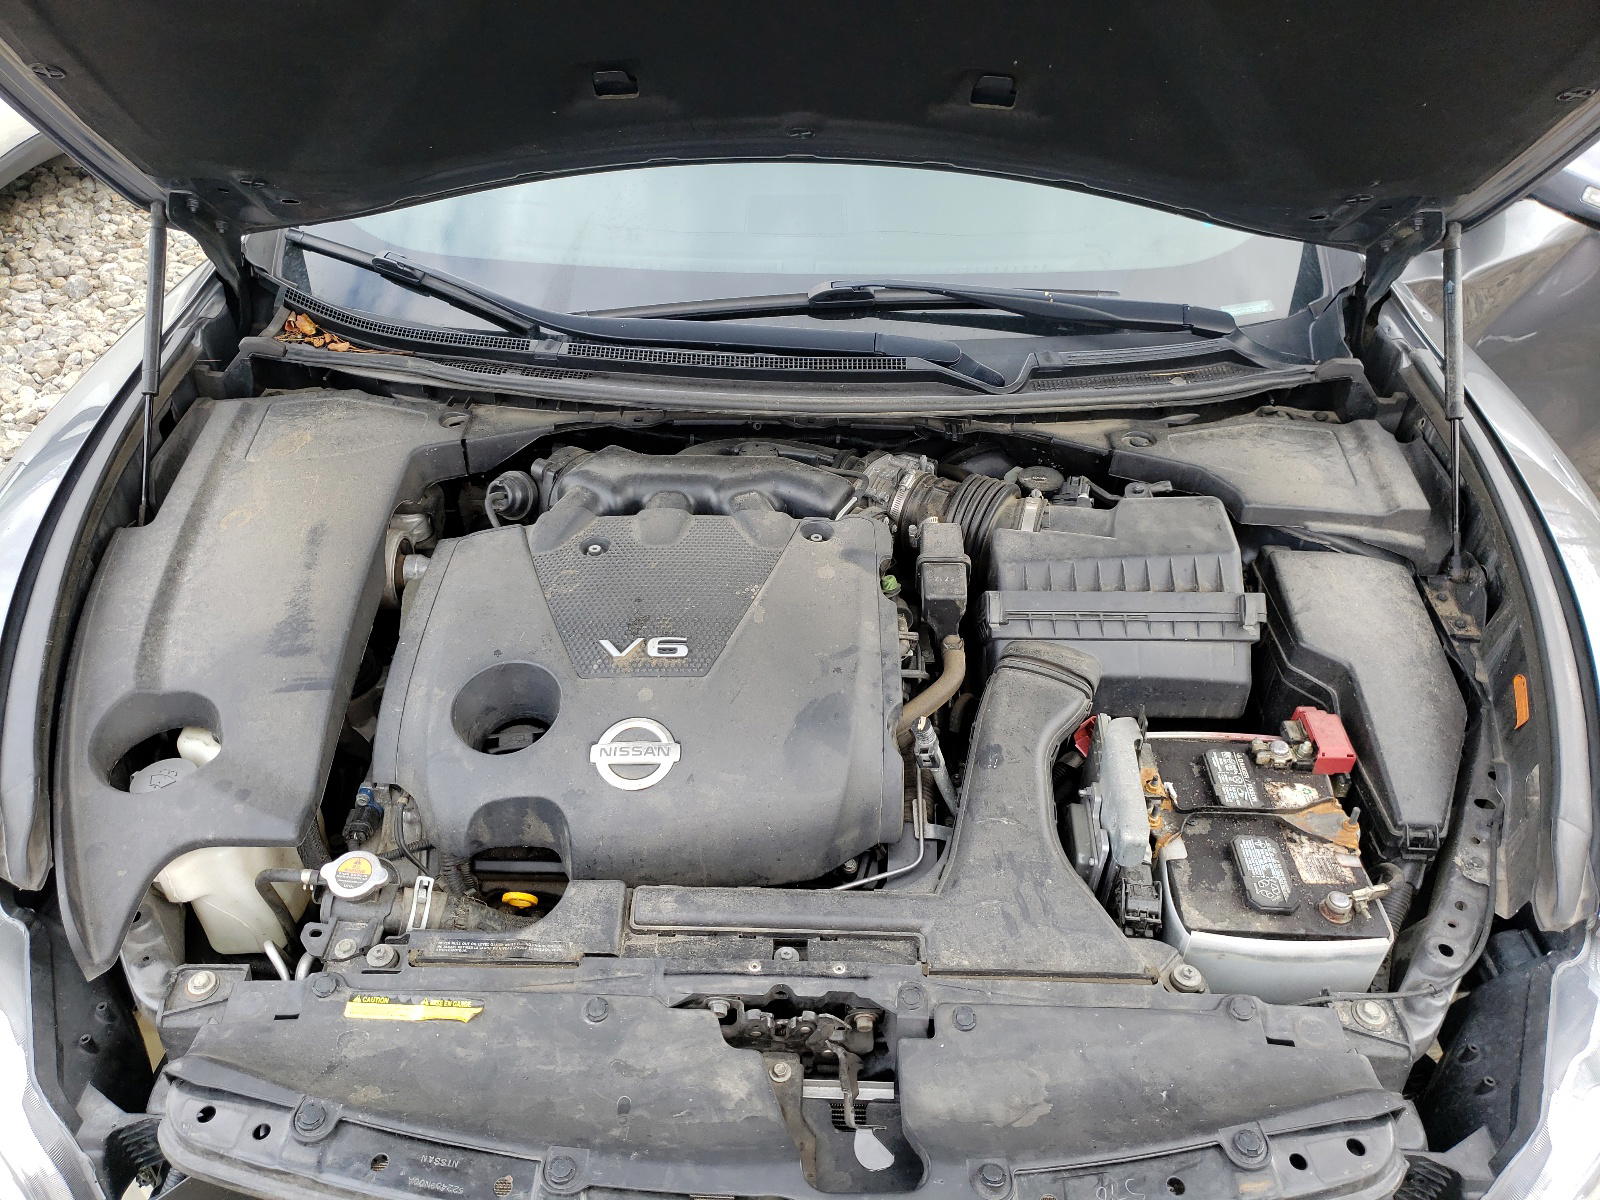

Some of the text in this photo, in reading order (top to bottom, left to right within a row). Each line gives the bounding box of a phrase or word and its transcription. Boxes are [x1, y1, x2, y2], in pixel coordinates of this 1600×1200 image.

[599, 637, 689, 658] V6
[599, 746, 670, 757] NISSAN
[362, 996, 390, 1004] CAUTION
[420, 1155, 460, 1168] NISSAN
